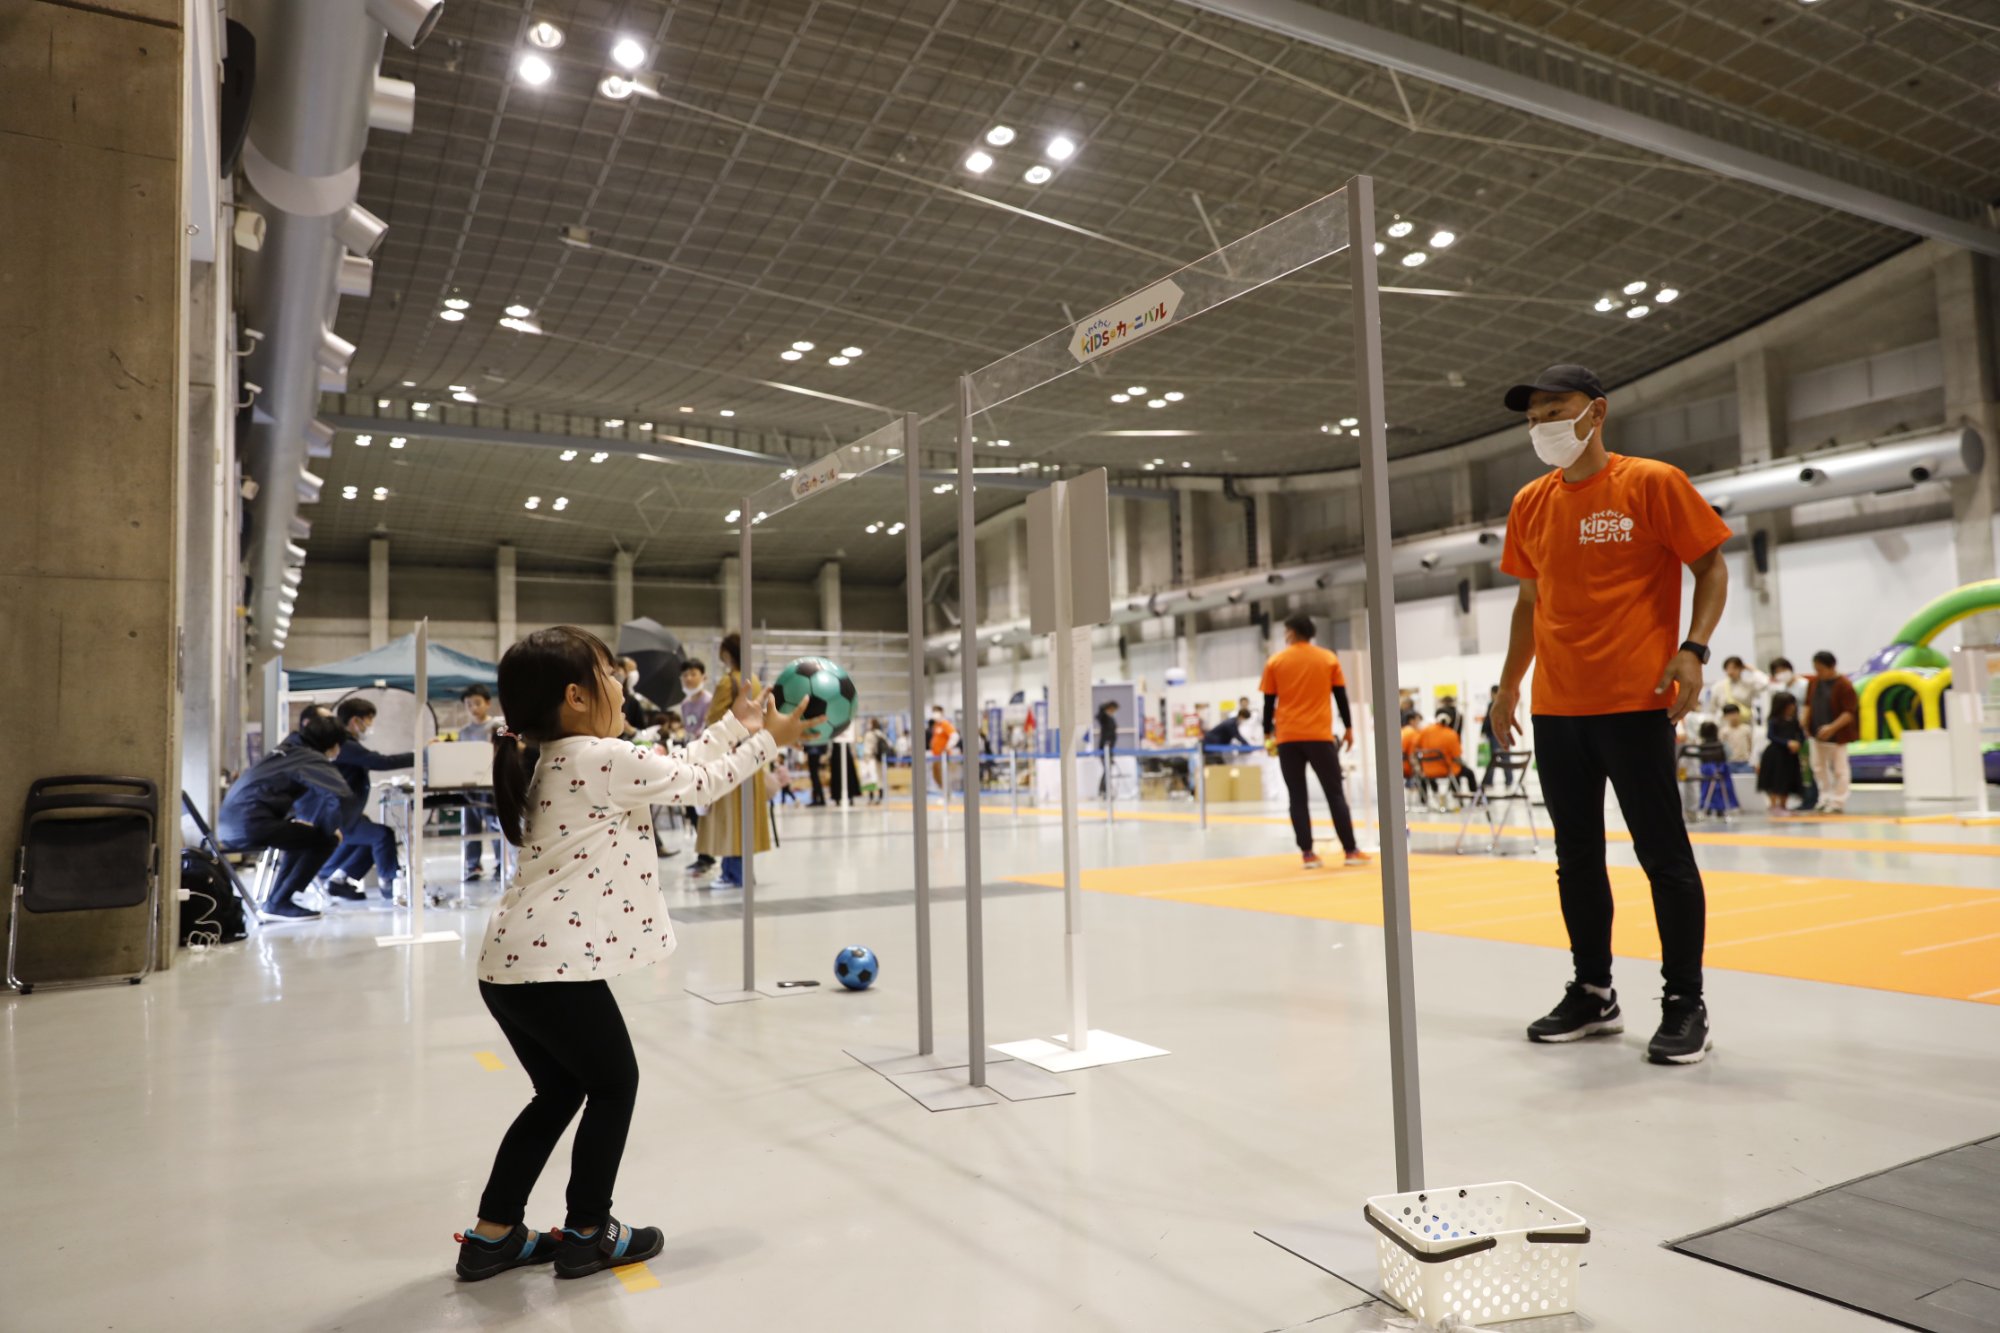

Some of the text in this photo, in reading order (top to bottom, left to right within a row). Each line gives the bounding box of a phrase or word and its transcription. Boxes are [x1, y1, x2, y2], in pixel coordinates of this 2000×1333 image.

[1579, 531, 1633, 545] カーニバル
